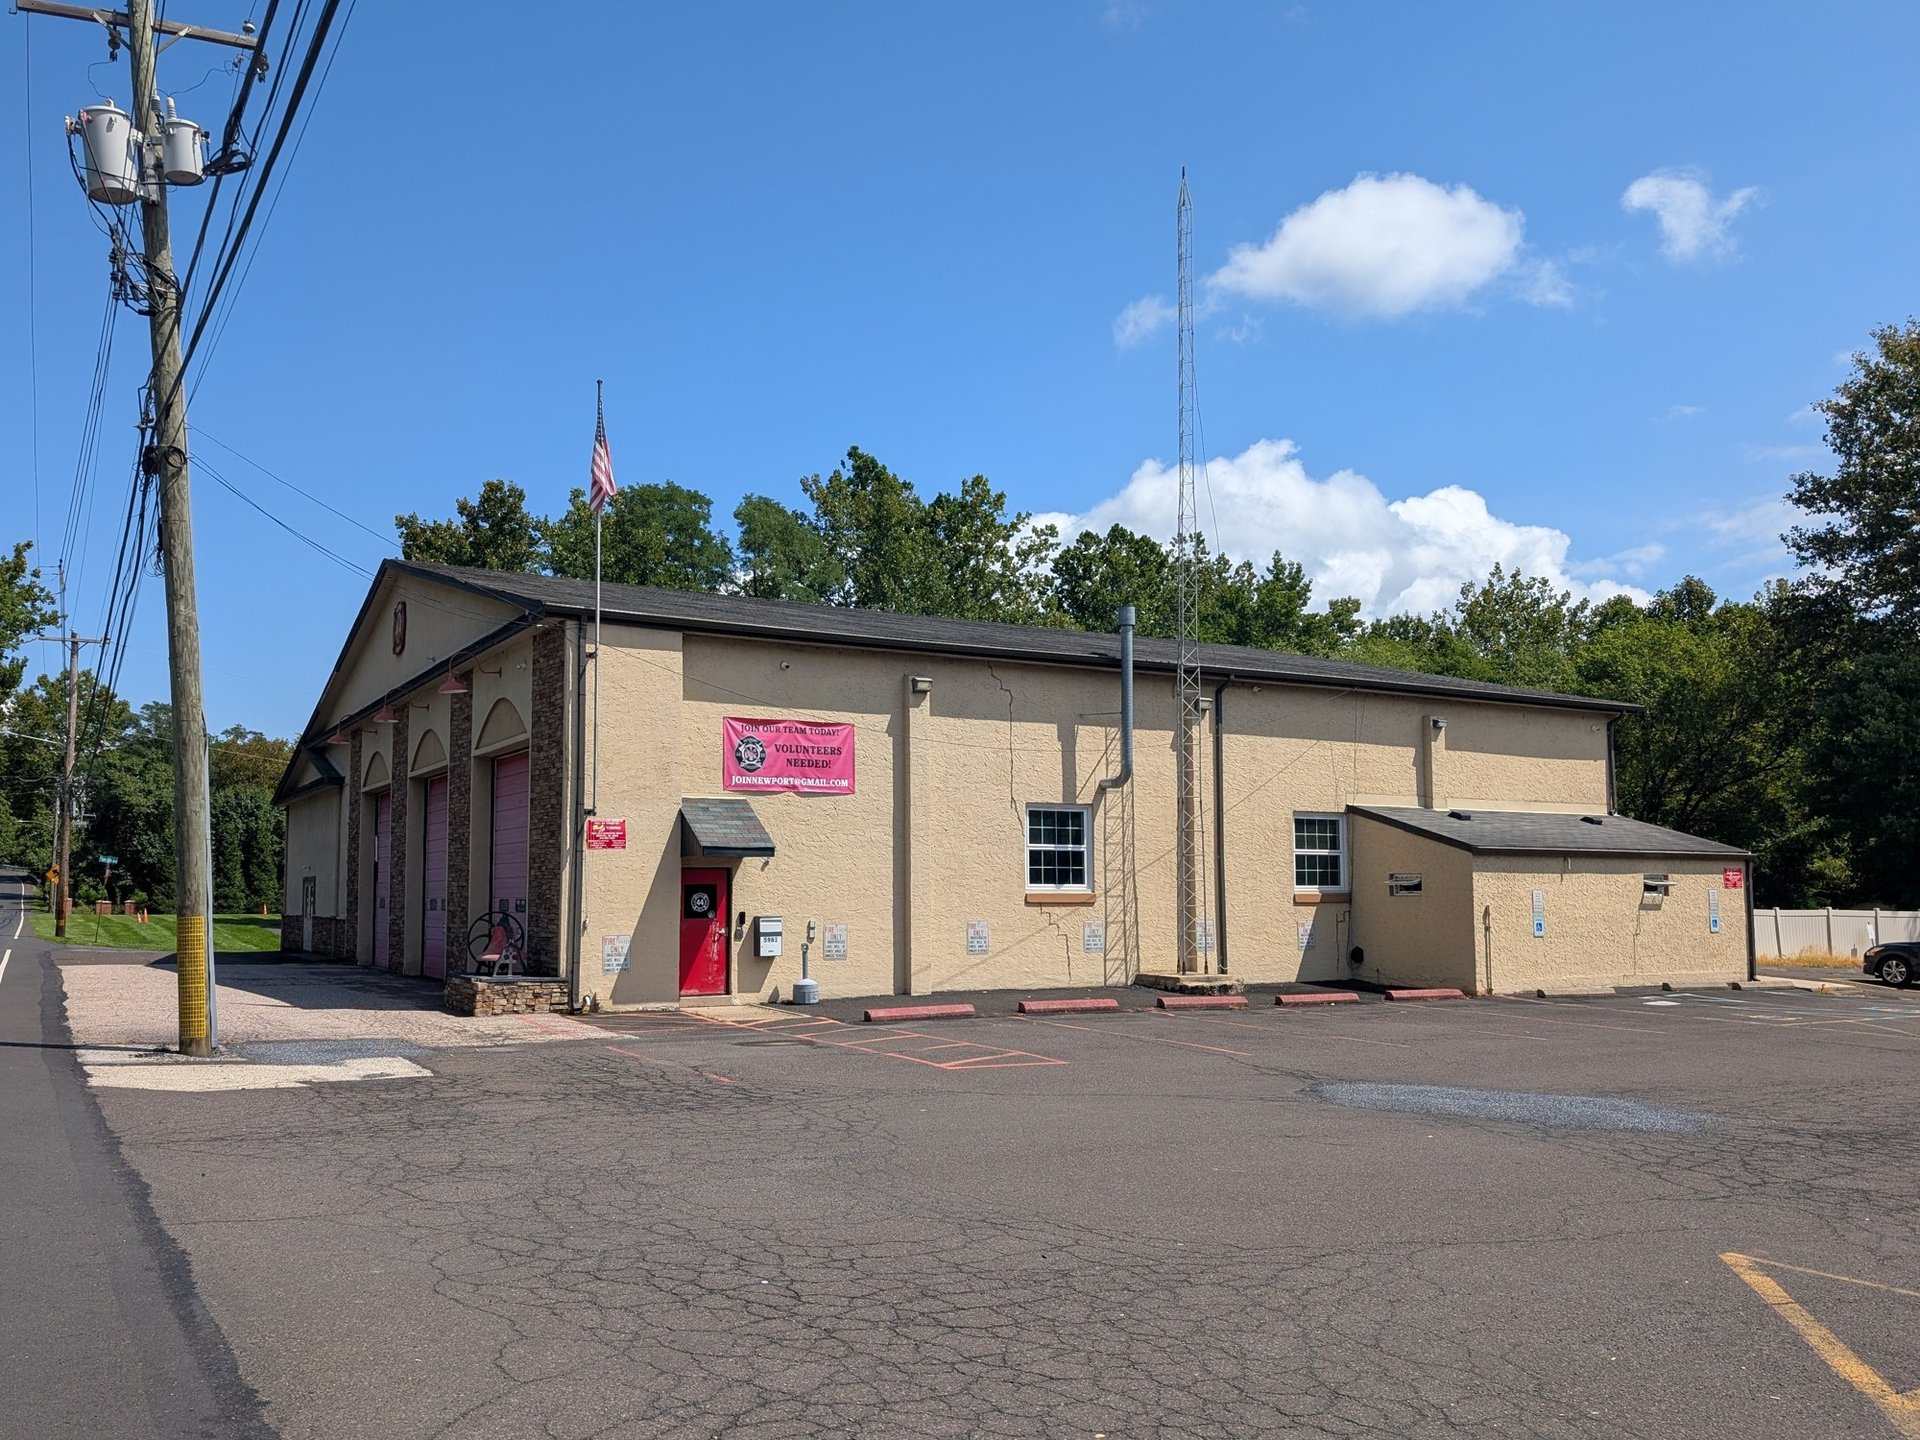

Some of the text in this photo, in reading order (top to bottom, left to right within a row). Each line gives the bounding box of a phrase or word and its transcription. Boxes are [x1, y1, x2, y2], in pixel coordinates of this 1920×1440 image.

[740, 724, 840, 736] JOIN OUR TEAM TODAY!
[774, 744, 842, 756] VOLUNTEERS
[786, 758, 832, 769] NEEDED!
[731, 775, 849, 787] JOINNEWPORT@GMAIL.COM
